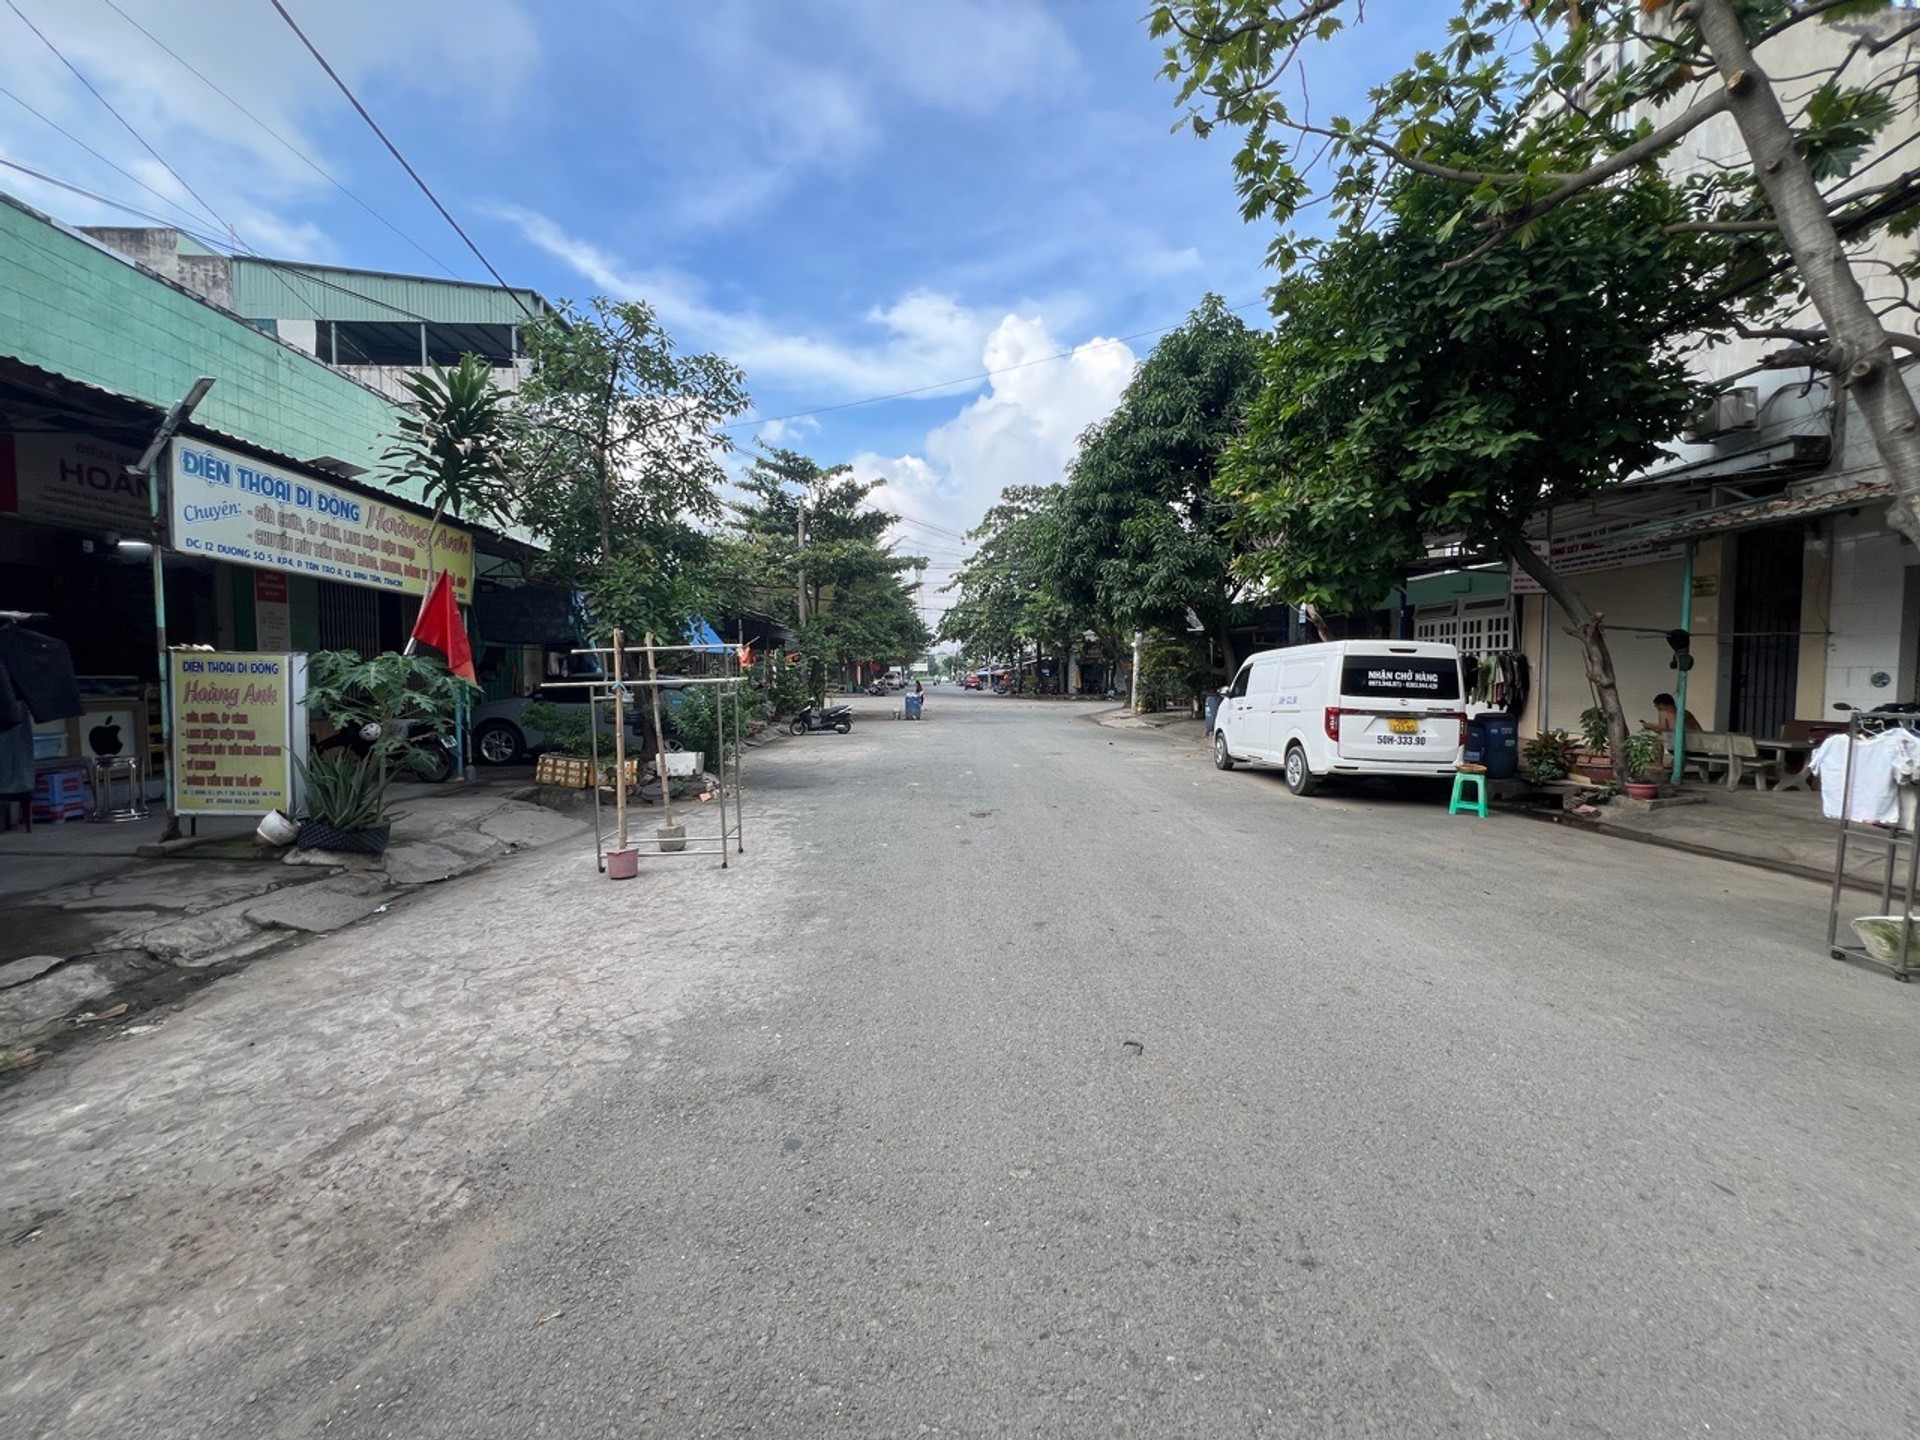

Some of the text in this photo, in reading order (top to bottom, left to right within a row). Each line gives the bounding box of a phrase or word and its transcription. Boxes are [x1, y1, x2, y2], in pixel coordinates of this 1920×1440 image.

[182, 449, 232, 486] ĐIỆN
[236, 466, 292, 506] THOẠI
[295, 485, 313, 509] DI
[317, 492, 361, 523] ĐỘNG
[434, 528, 470, 556] Anh
[184, 501, 243, 523] Chuyên:
[205, 542, 214, 552] 12
[238, 661, 247, 673] DI
[183, 680, 278, 709] Hoàng Anh
